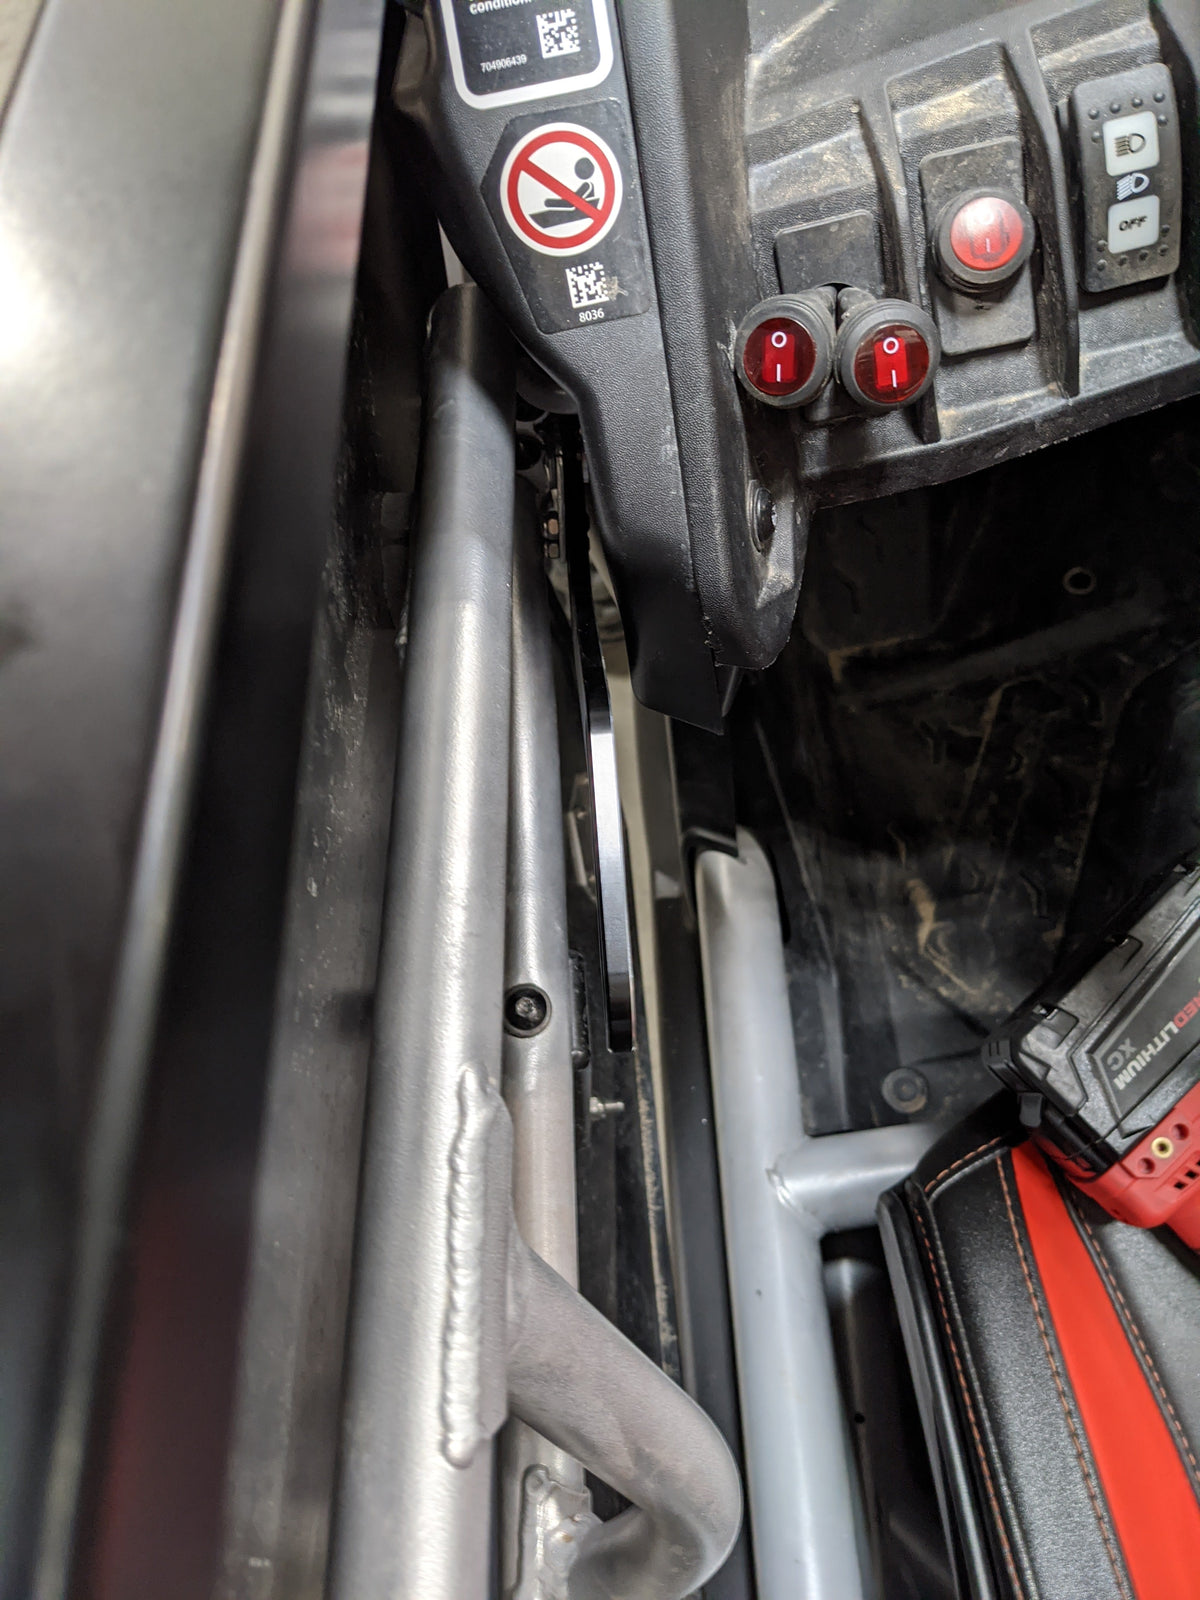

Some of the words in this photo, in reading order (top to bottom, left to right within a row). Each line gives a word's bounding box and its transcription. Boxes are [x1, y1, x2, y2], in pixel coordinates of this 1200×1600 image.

[469, 0, 532, 15] conditio
[480, 54, 528, 73] 704906439
[1119, 215, 1147, 231] OFF
[578, 308, 605, 322] 8036
[1106, 1037, 1137, 1071] XC
